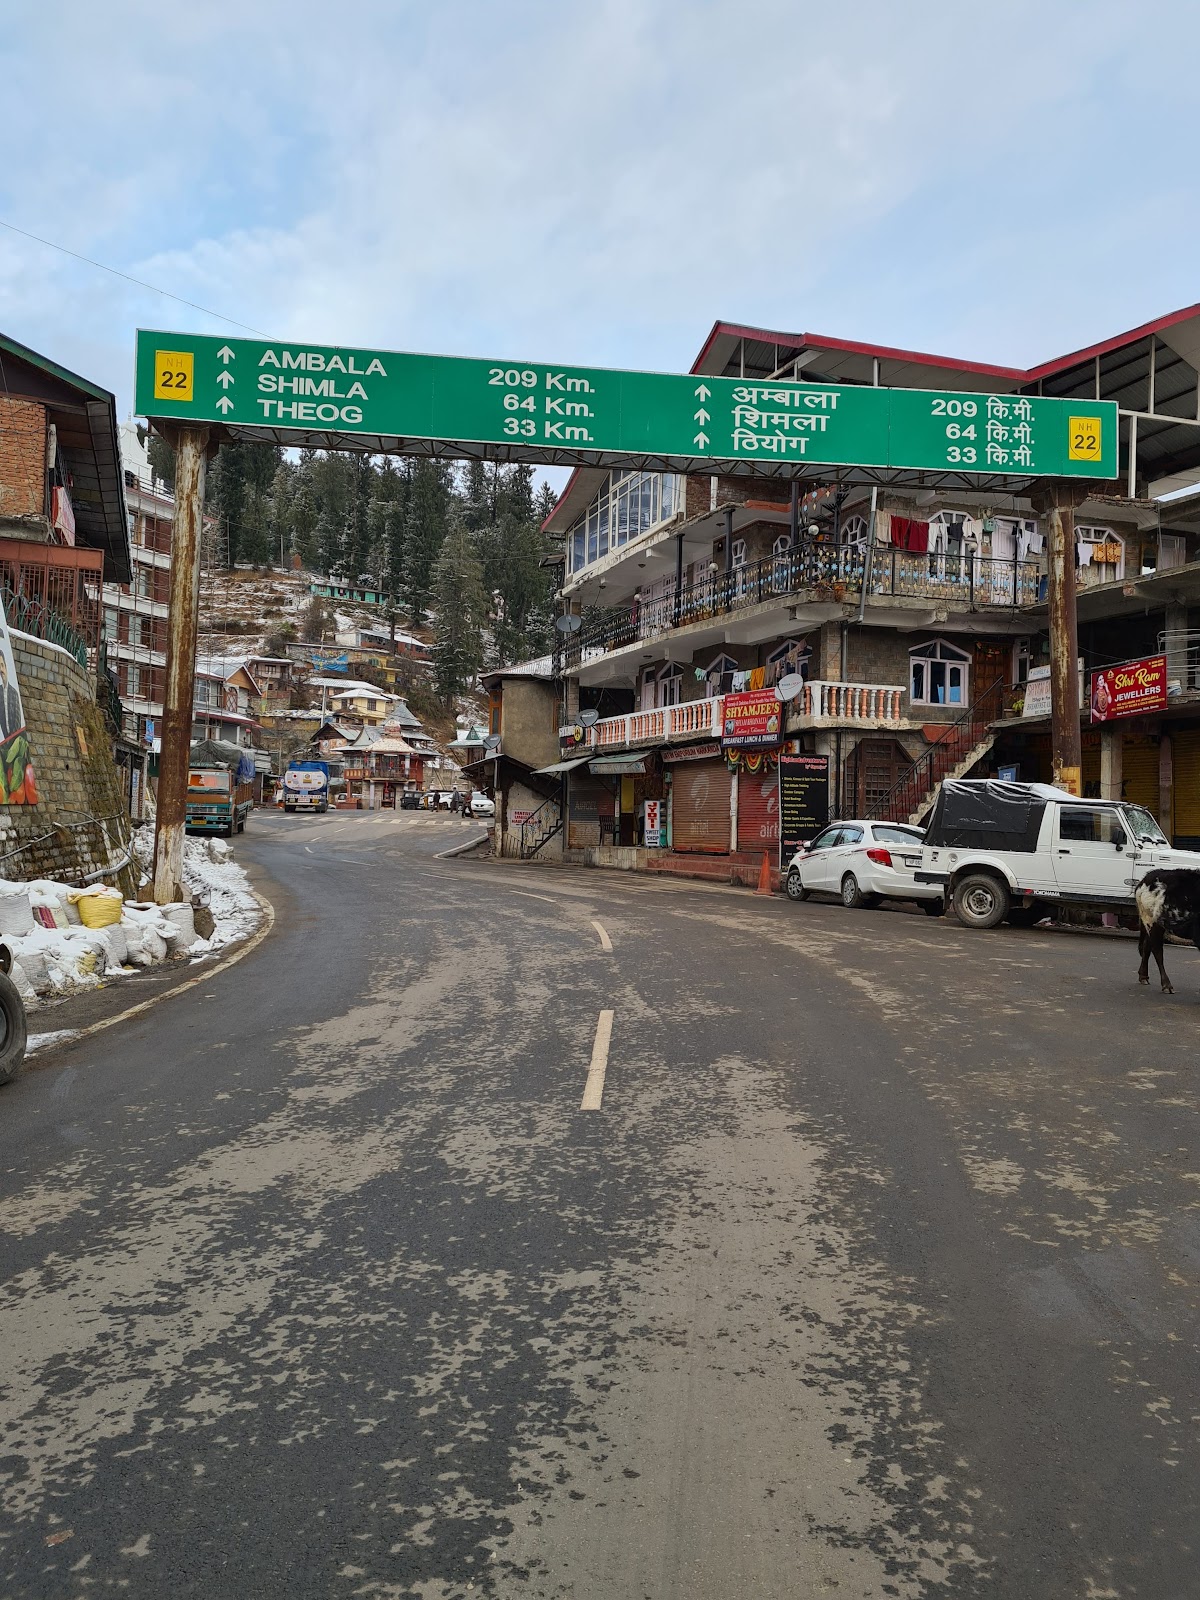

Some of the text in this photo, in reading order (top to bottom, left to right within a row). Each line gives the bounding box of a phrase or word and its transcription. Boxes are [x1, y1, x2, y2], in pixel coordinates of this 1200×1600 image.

[161, 371, 187, 389] 22
[259, 350, 594, 392] AMBALA 209 Km.
[258, 374, 594, 416] SHIMLA 64 Km.
[732, 387, 1035, 421] अम्बाला 209 कि.मी.
[257, 399, 593, 440] THEOG 33 Km.
[731, 405, 1035, 444] शिमला 64 कि.मी.
[731, 428, 1035, 467] ठियोग 33 कि.मी.
[1075, 434, 1096, 449] 22
[1115, 674, 1135, 689] Shri
[1135, 668, 1160, 687] Ram
[1115, 686, 1161, 702] JEWELLERS
[726, 702, 780, 718] SHYAMJEE'S
[723, 736, 744, 745] BREAKFAST
[745, 735, 757, 743] LUNCH
[762, 734, 778, 742] DINNER
[648, 802, 658, 829] JYOTI
